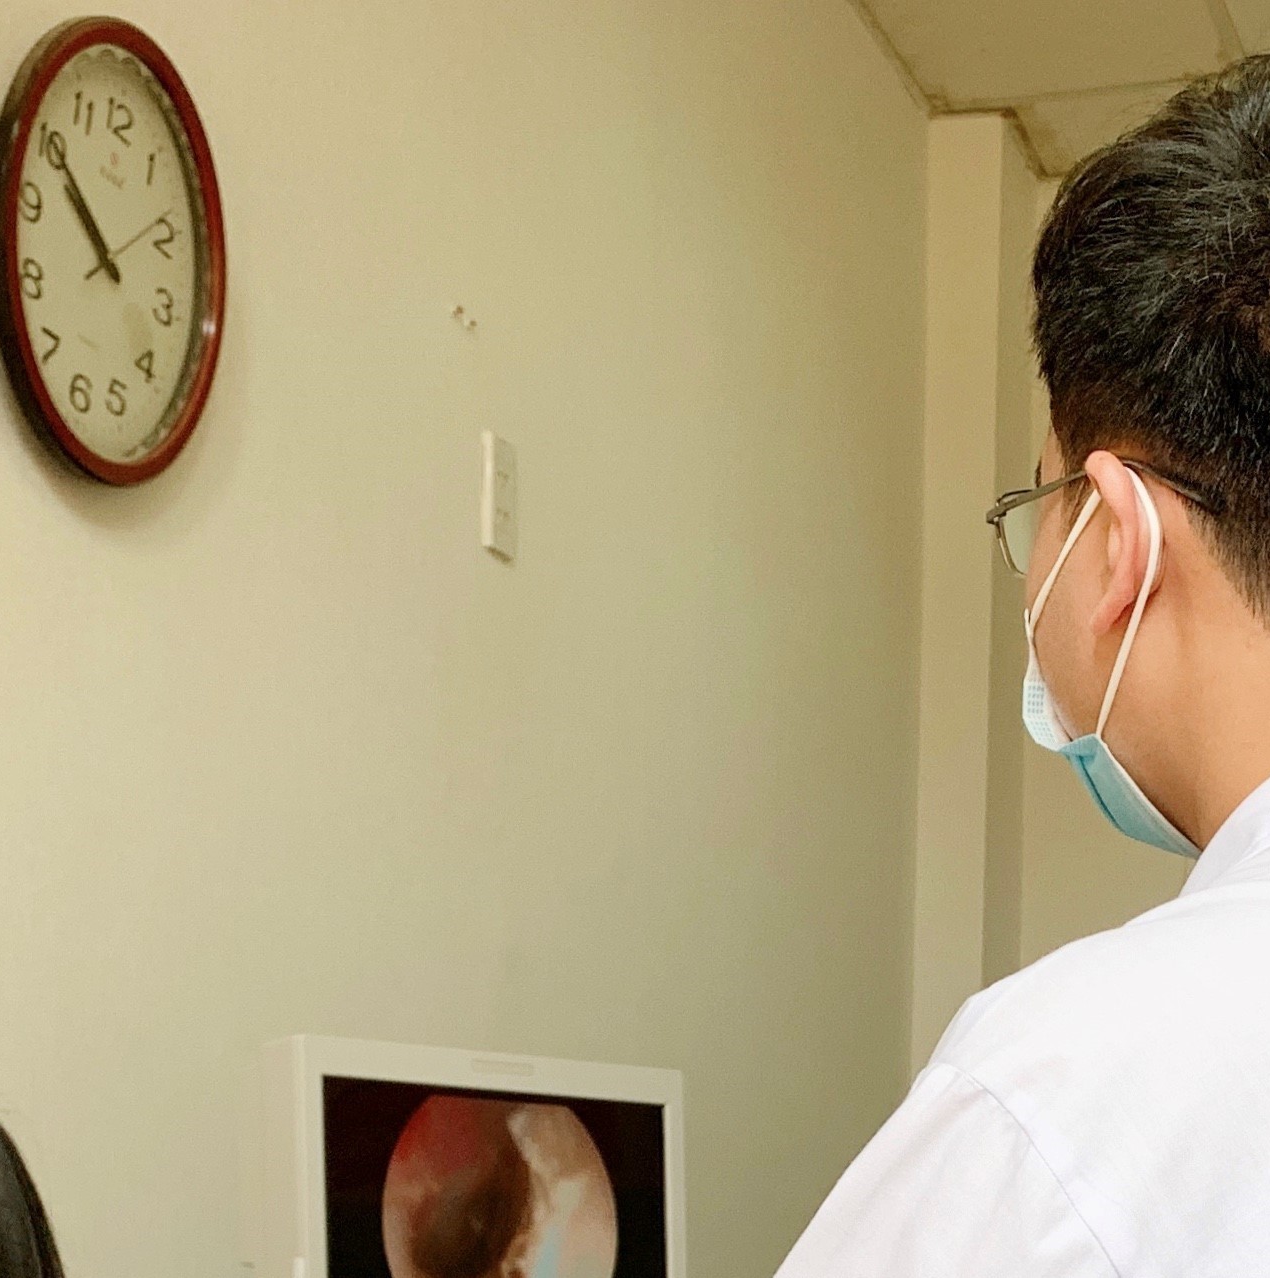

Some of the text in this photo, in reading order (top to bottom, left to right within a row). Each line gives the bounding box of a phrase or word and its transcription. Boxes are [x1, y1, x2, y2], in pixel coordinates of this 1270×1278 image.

[73, 91, 93, 136] 11
[106, 97, 134, 147] 12
[38, 122, 67, 170] 10
[146, 153, 156, 186] 1
[20, 182, 42, 223] 9
[152, 217, 176, 260] 2
[22, 257, 44, 300] 8
[151, 287, 174, 327] 3
[40, 326, 61, 365] 7
[134, 350, 155, 384] 4
[68, 373, 93, 413] 6
[104, 378, 127, 417] 5
